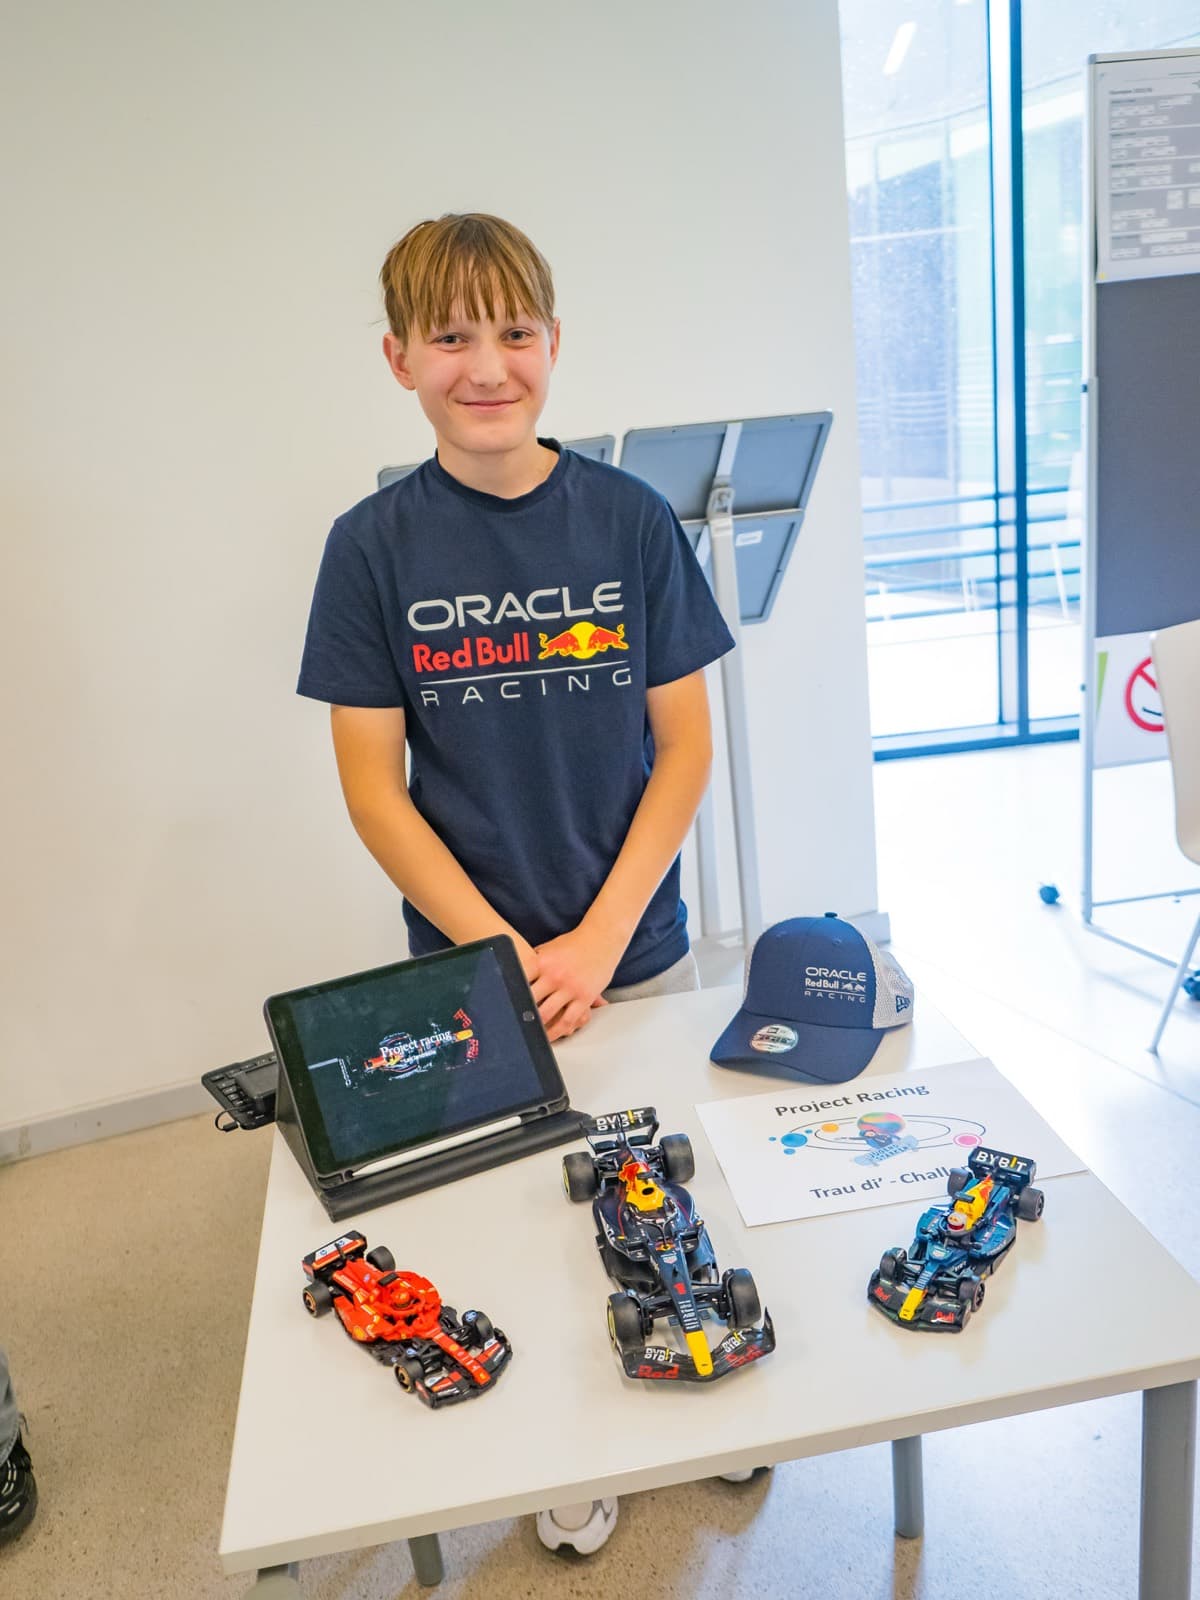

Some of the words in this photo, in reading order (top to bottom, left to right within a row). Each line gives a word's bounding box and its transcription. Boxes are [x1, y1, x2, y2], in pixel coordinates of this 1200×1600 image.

[407, 581, 625, 632] ORACLE
[412, 637, 473, 673] Red
[475, 631, 530, 667] Bull
[420, 667, 632, 707] RACING
[805, 966, 867, 982] ORACLE
[805, 978, 822, 988] Red
[822, 980, 839, 989] Bull
[804, 990, 866, 1004] RACING
[379, 1039, 419, 1058] Project
[419, 1030, 452, 1046] racing
[775, 1096, 853, 1117] Project
[856, 1085, 930, 1103] Racing
[596, 1109, 645, 1132] BYBIT
[975, 1150, 1029, 1172] BYBIT
[809, 1184, 856, 1200] Trau
[900, 1164, 968, 1185] Chall
[722, 1330, 748, 1353] BYBIT
[644, 1347, 677, 1364] BYBIT
